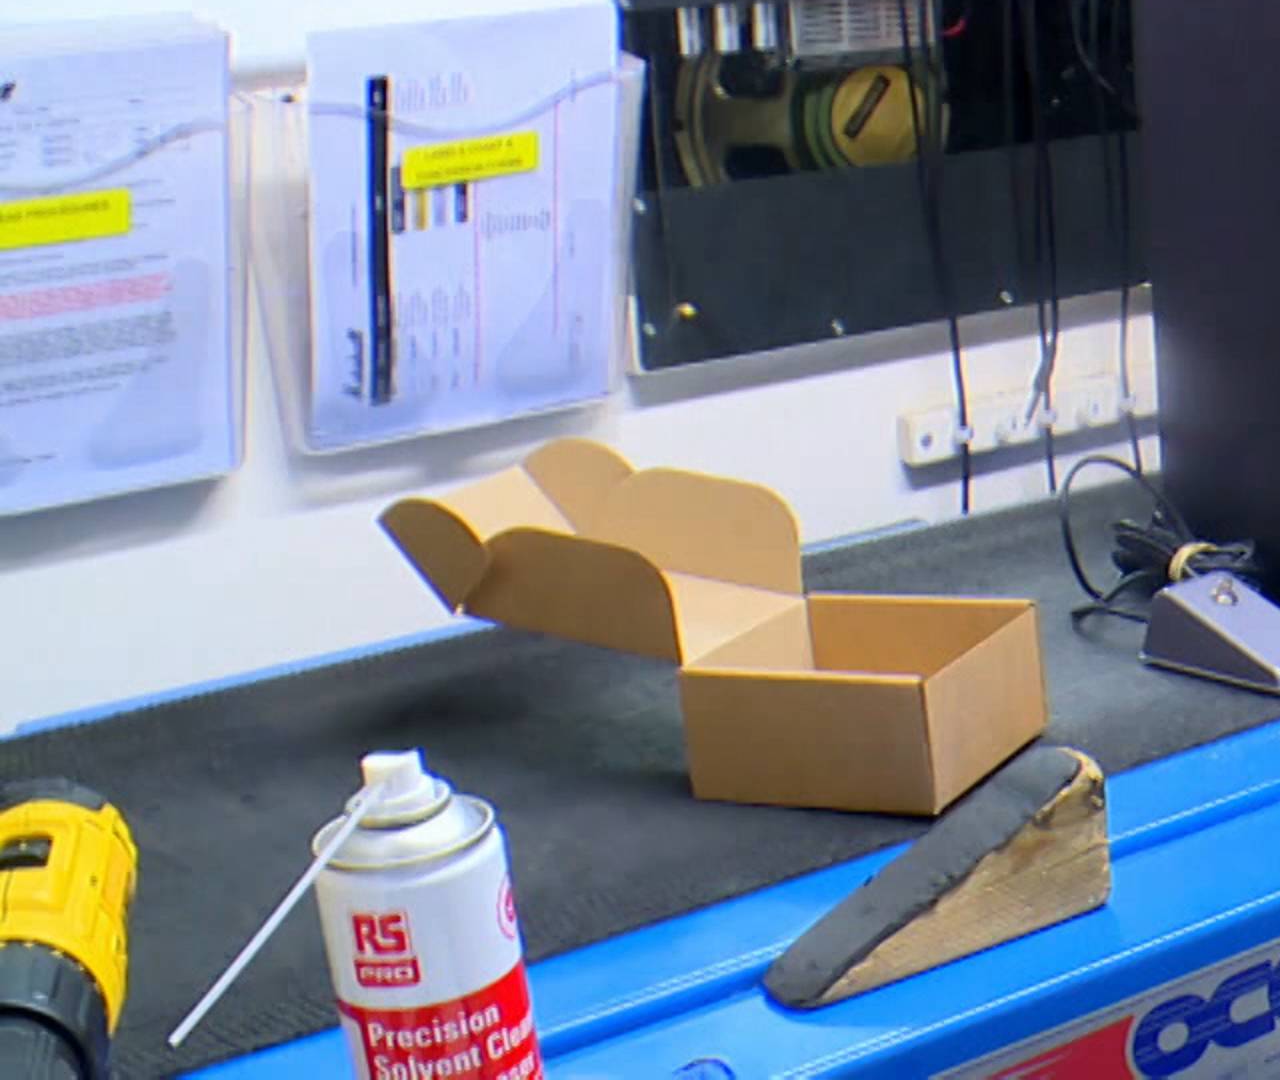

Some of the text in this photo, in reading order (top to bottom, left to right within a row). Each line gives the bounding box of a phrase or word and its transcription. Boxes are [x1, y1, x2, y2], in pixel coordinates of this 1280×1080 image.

[352, 913, 408, 954] RS
[359, 965, 415, 983] PRO
[367, 1003, 500, 1049] Precision
[373, 1045, 482, 1080] Solvent
